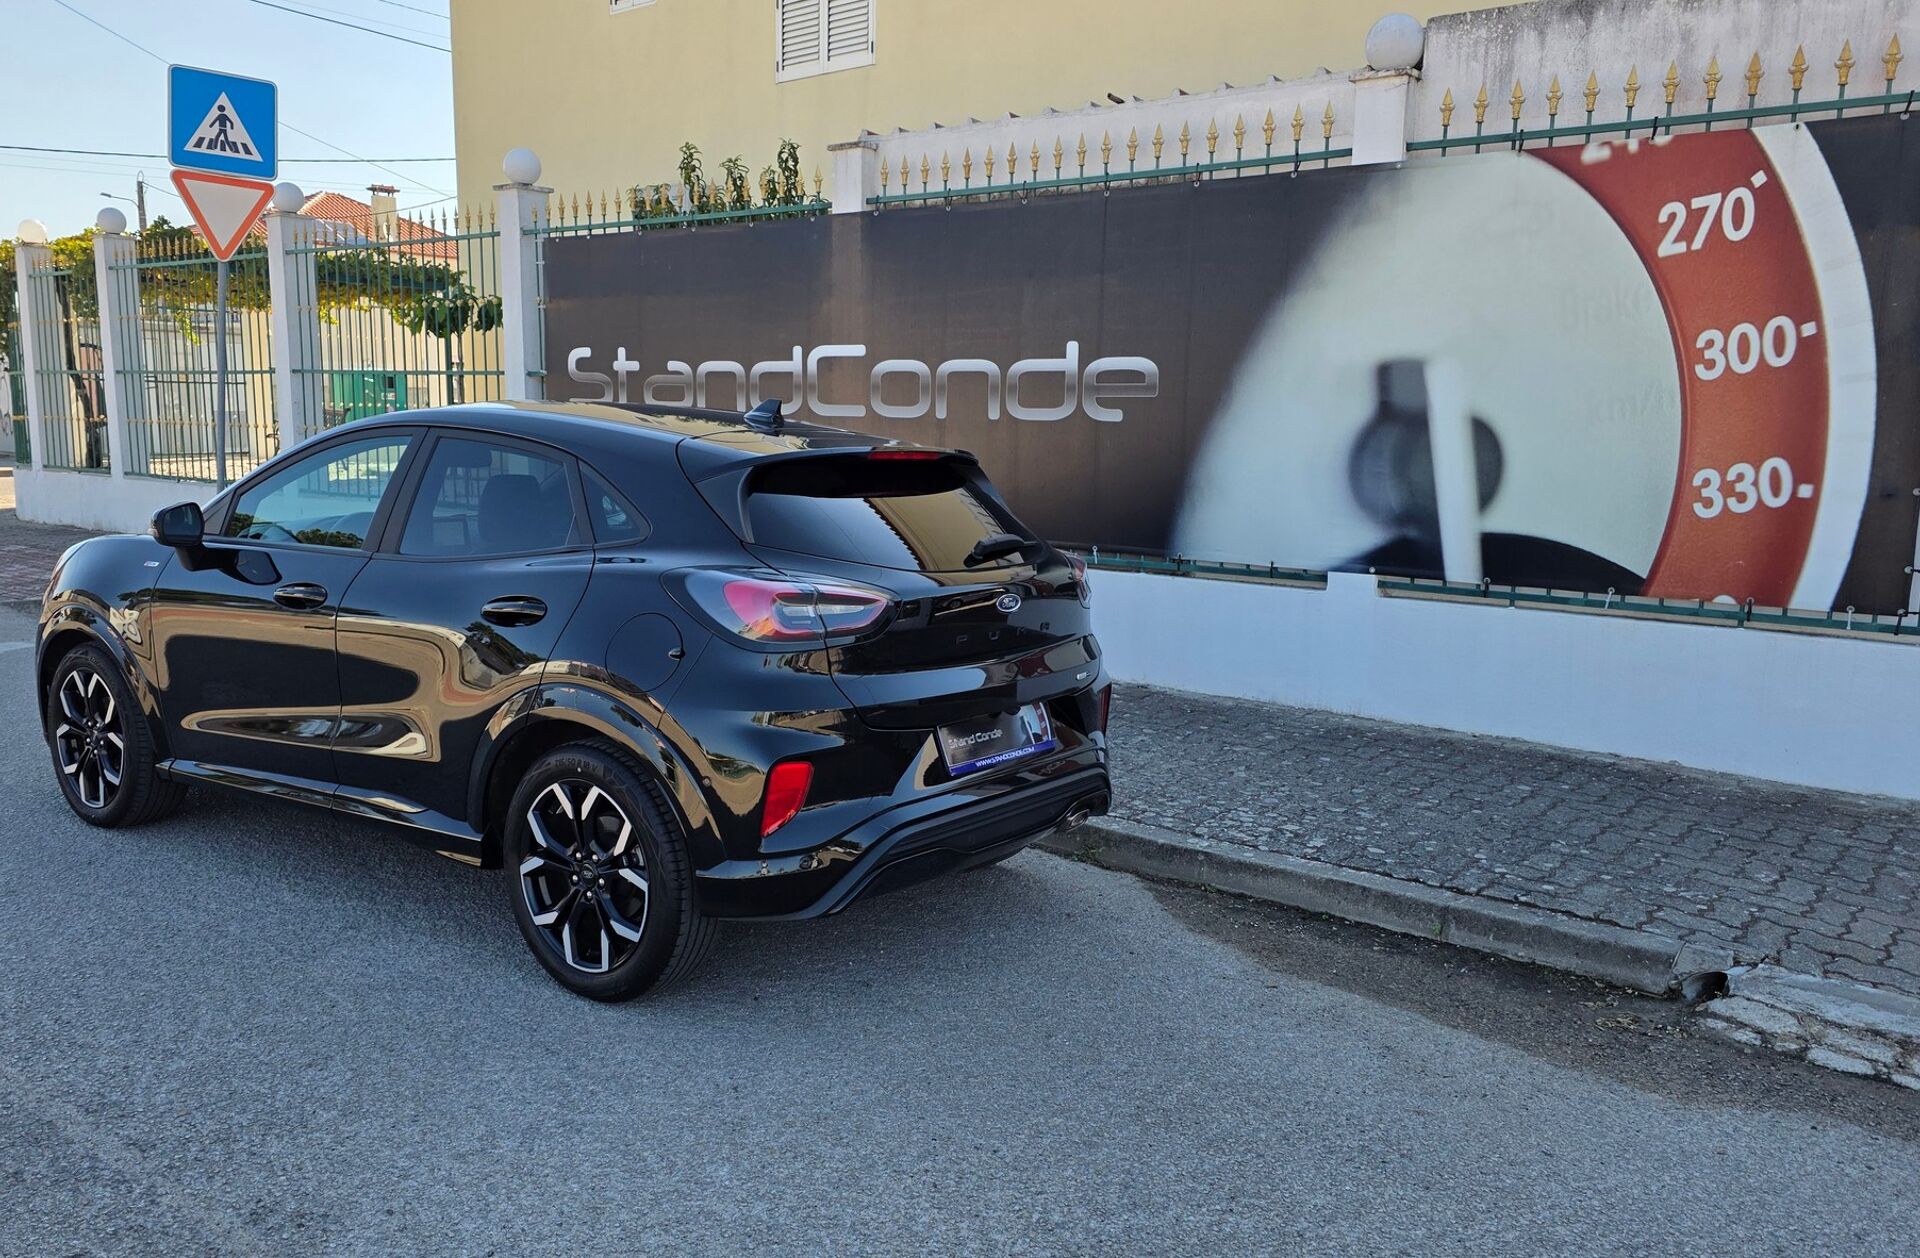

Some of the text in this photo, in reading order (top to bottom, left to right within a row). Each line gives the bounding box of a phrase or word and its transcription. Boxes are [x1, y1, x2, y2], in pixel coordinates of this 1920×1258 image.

[1656, 186, 1756, 259] 270
[1694, 315, 1798, 382] 300
[1690, 456, 1794, 519] 330
